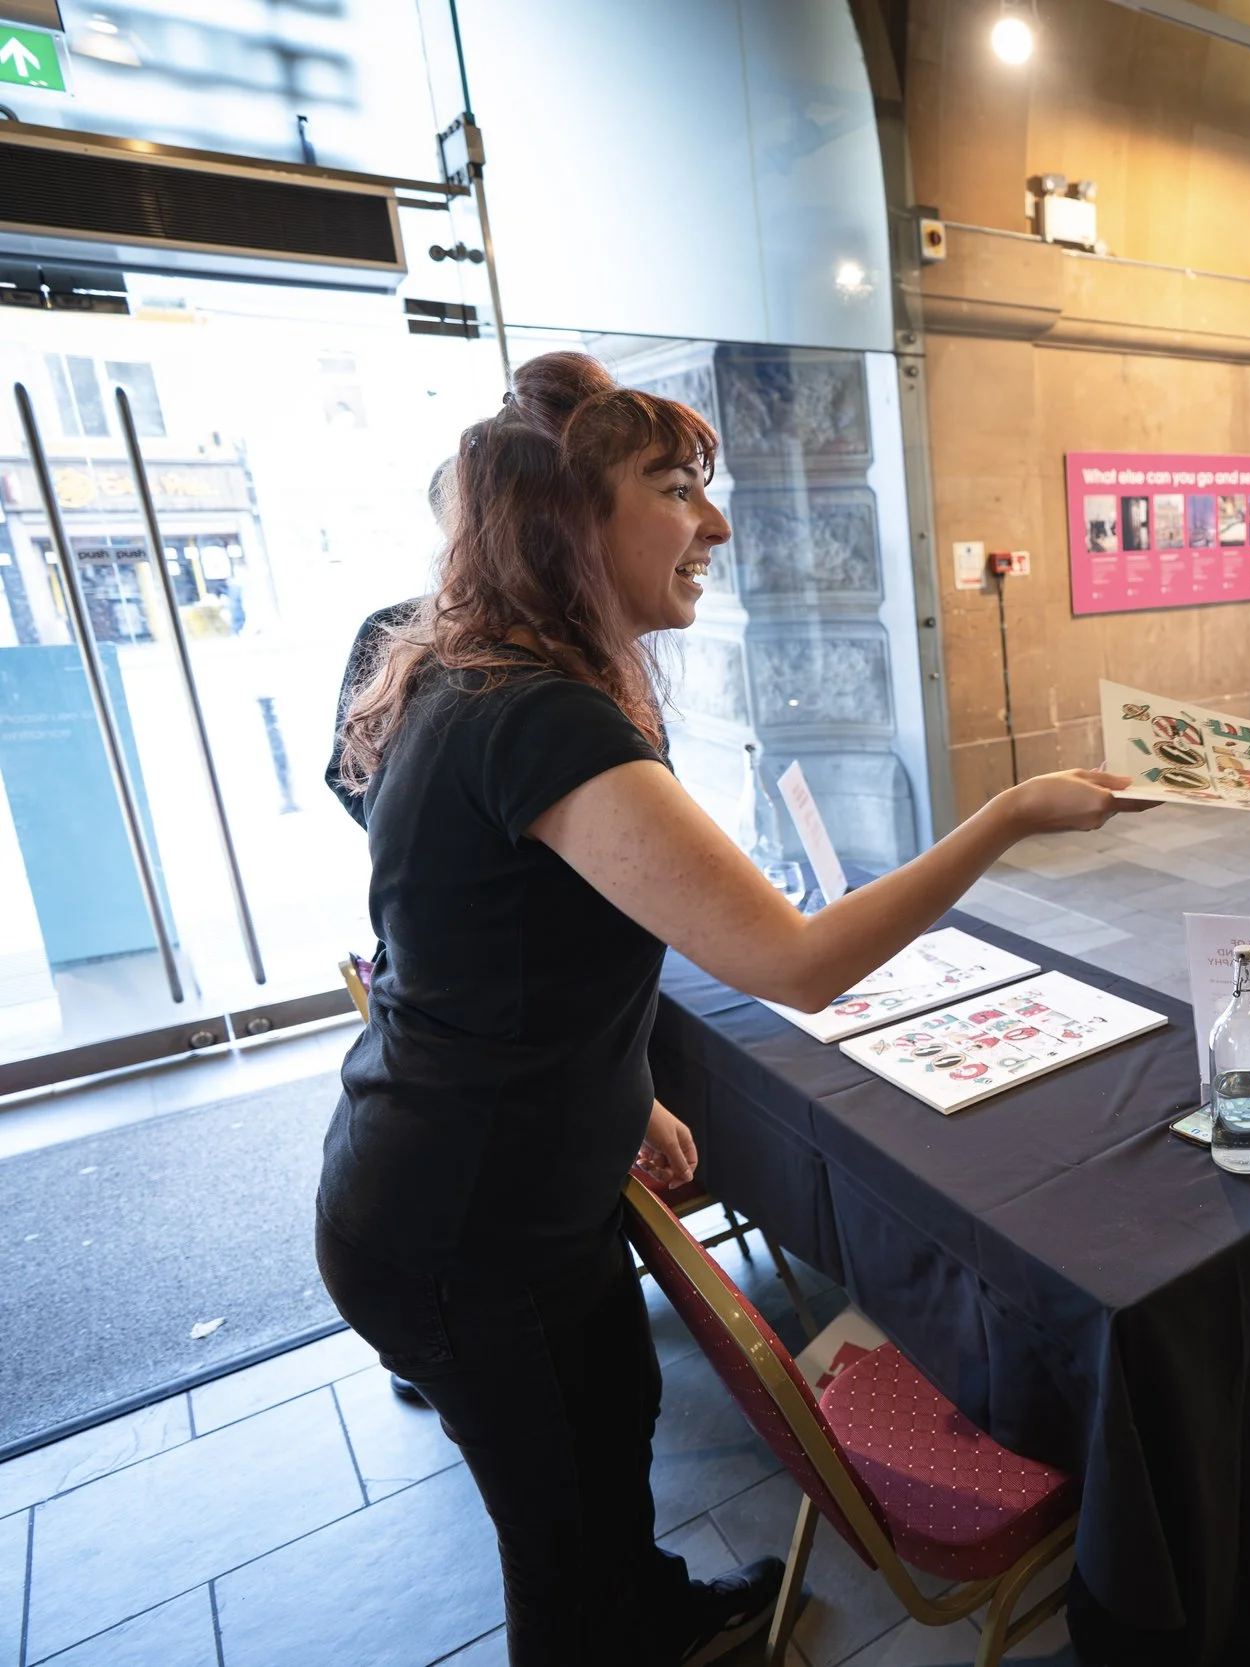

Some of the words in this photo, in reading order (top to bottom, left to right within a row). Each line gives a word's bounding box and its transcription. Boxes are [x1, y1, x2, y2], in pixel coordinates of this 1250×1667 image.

[1082, 468, 1116, 484] What
[1118, 469, 1145, 485] else
[1146, 471, 1171, 485] can
[1172, 472, 1196, 487] you
[1197, 471, 1214, 488] go
[1215, 470, 1239, 484] and
[78, 549, 110, 562] push
[115, 549, 147, 561] push
